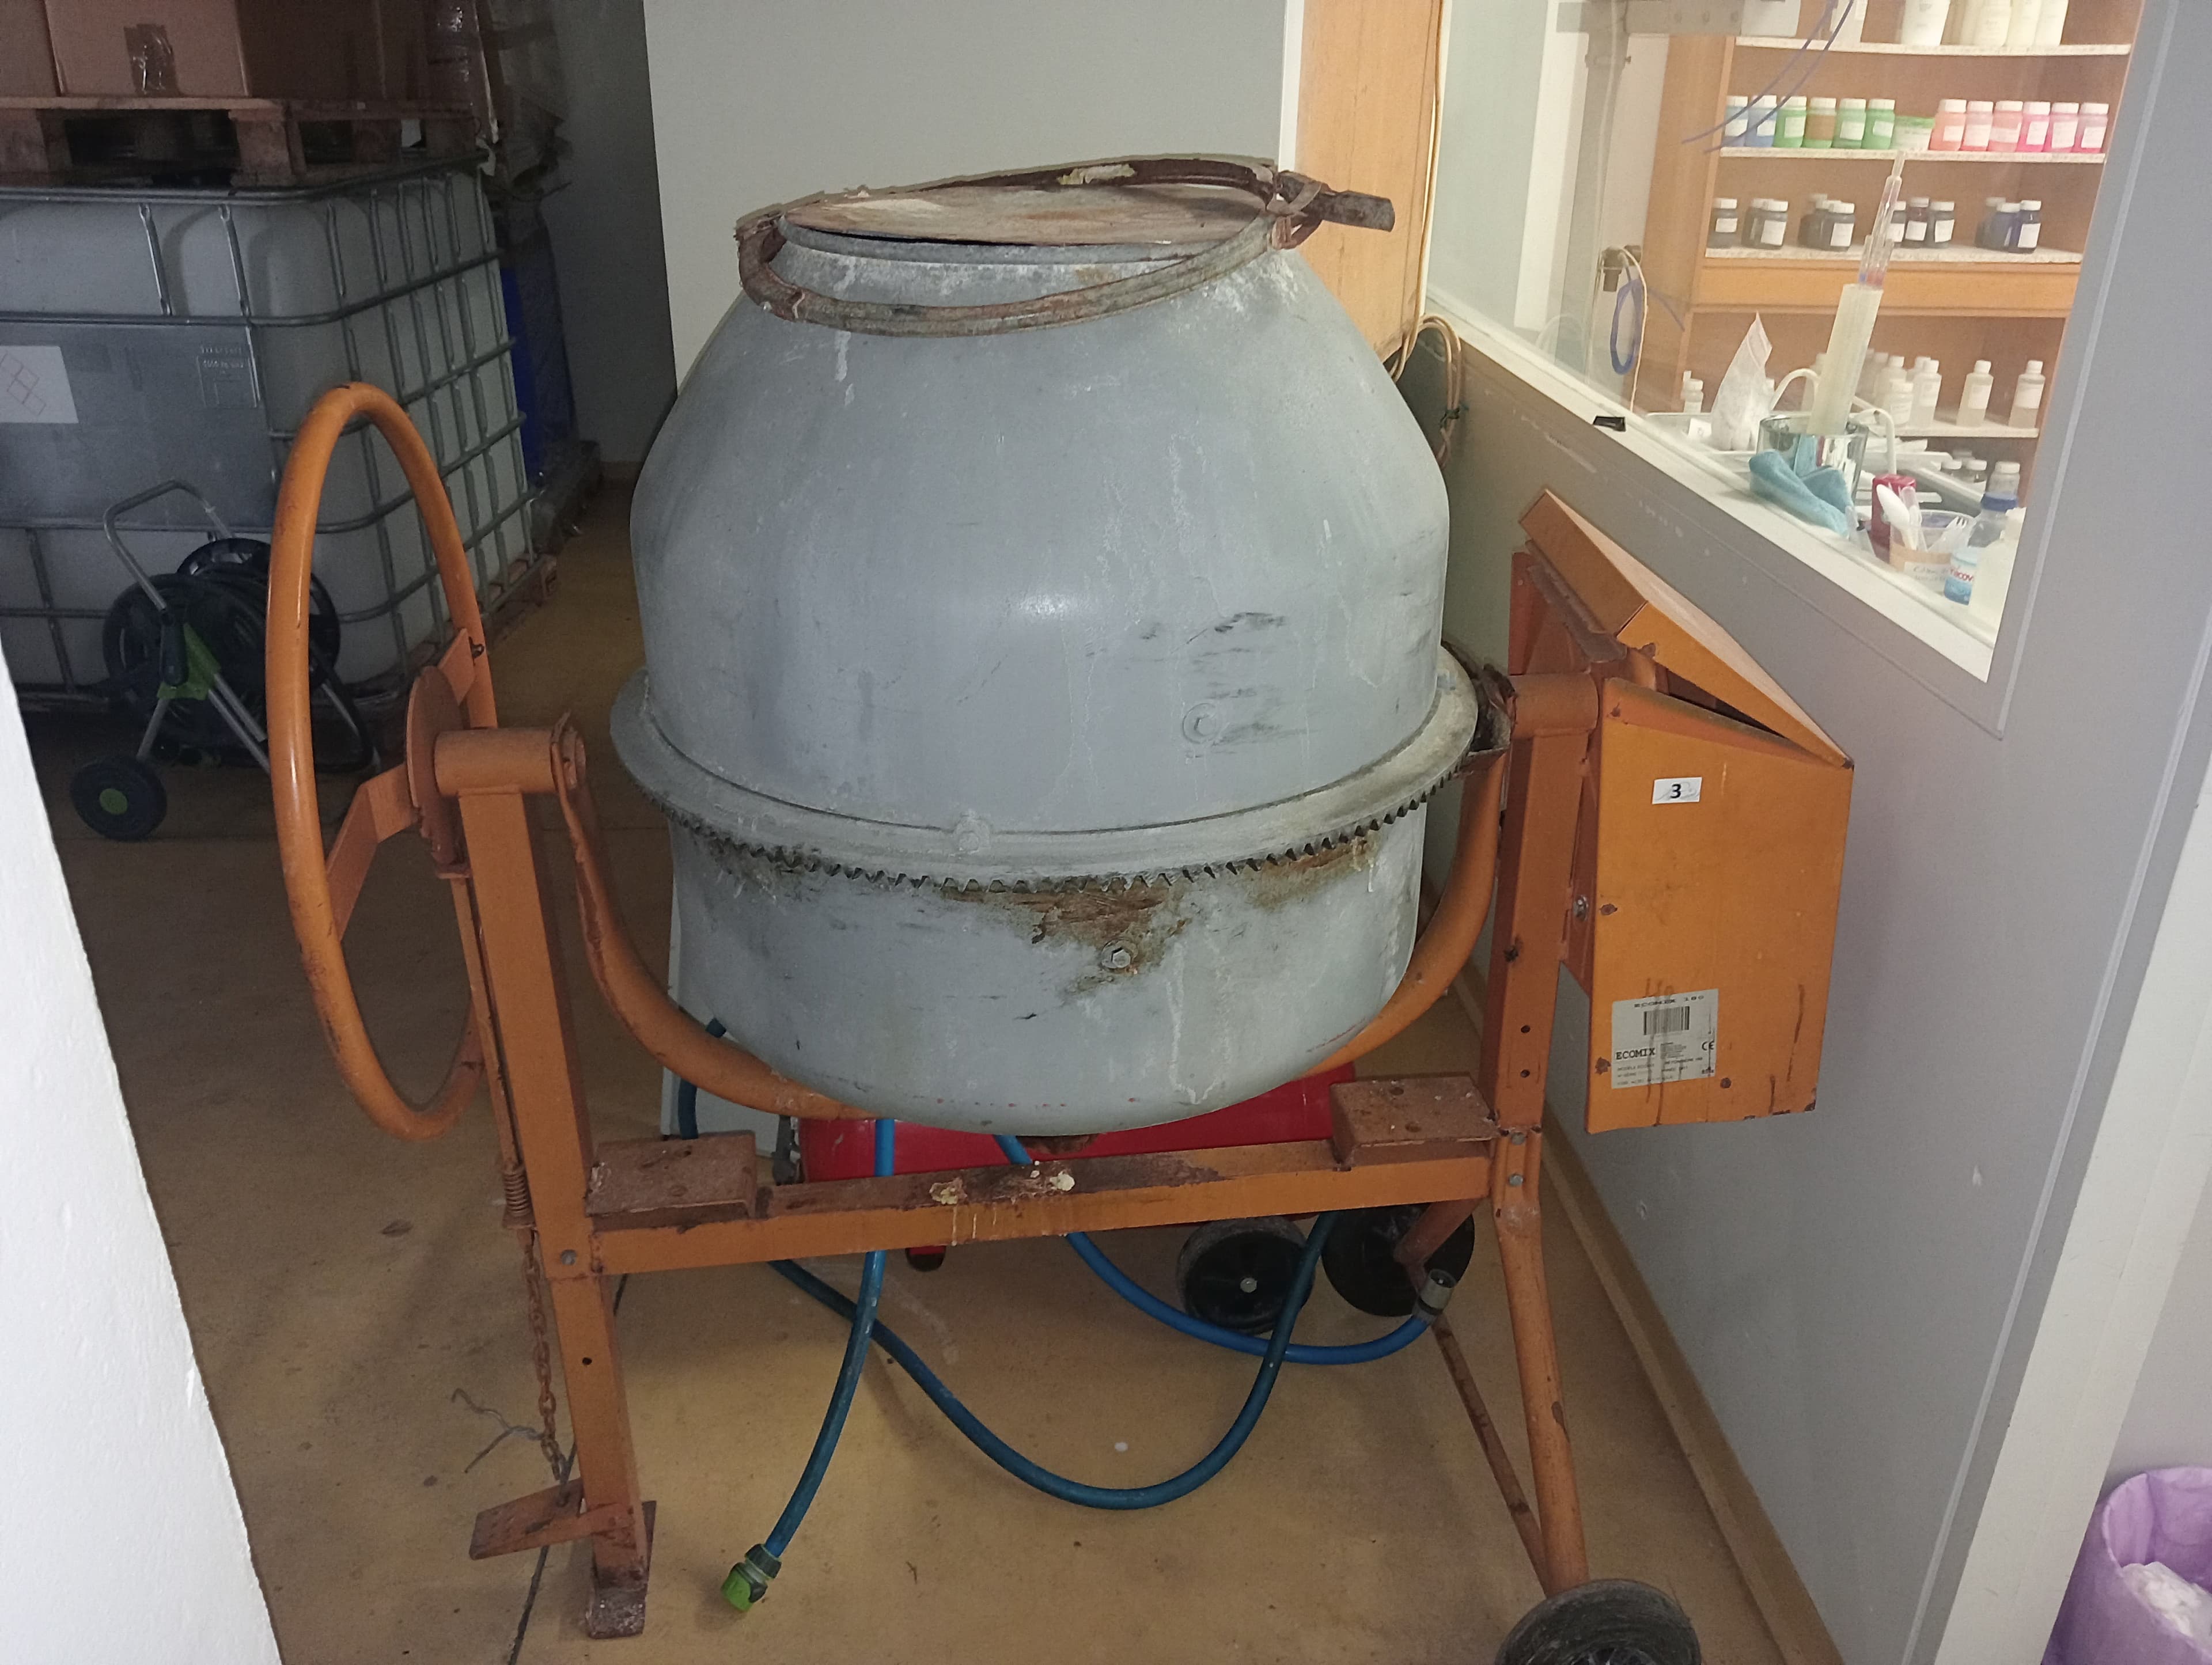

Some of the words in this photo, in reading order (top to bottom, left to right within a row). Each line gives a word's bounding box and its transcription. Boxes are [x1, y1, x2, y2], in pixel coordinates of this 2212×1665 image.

[1669, 783, 1681, 799] 3
[1702, 1041, 1714, 1050] CE
[1616, 1048, 1655, 1060] ECOMIX
